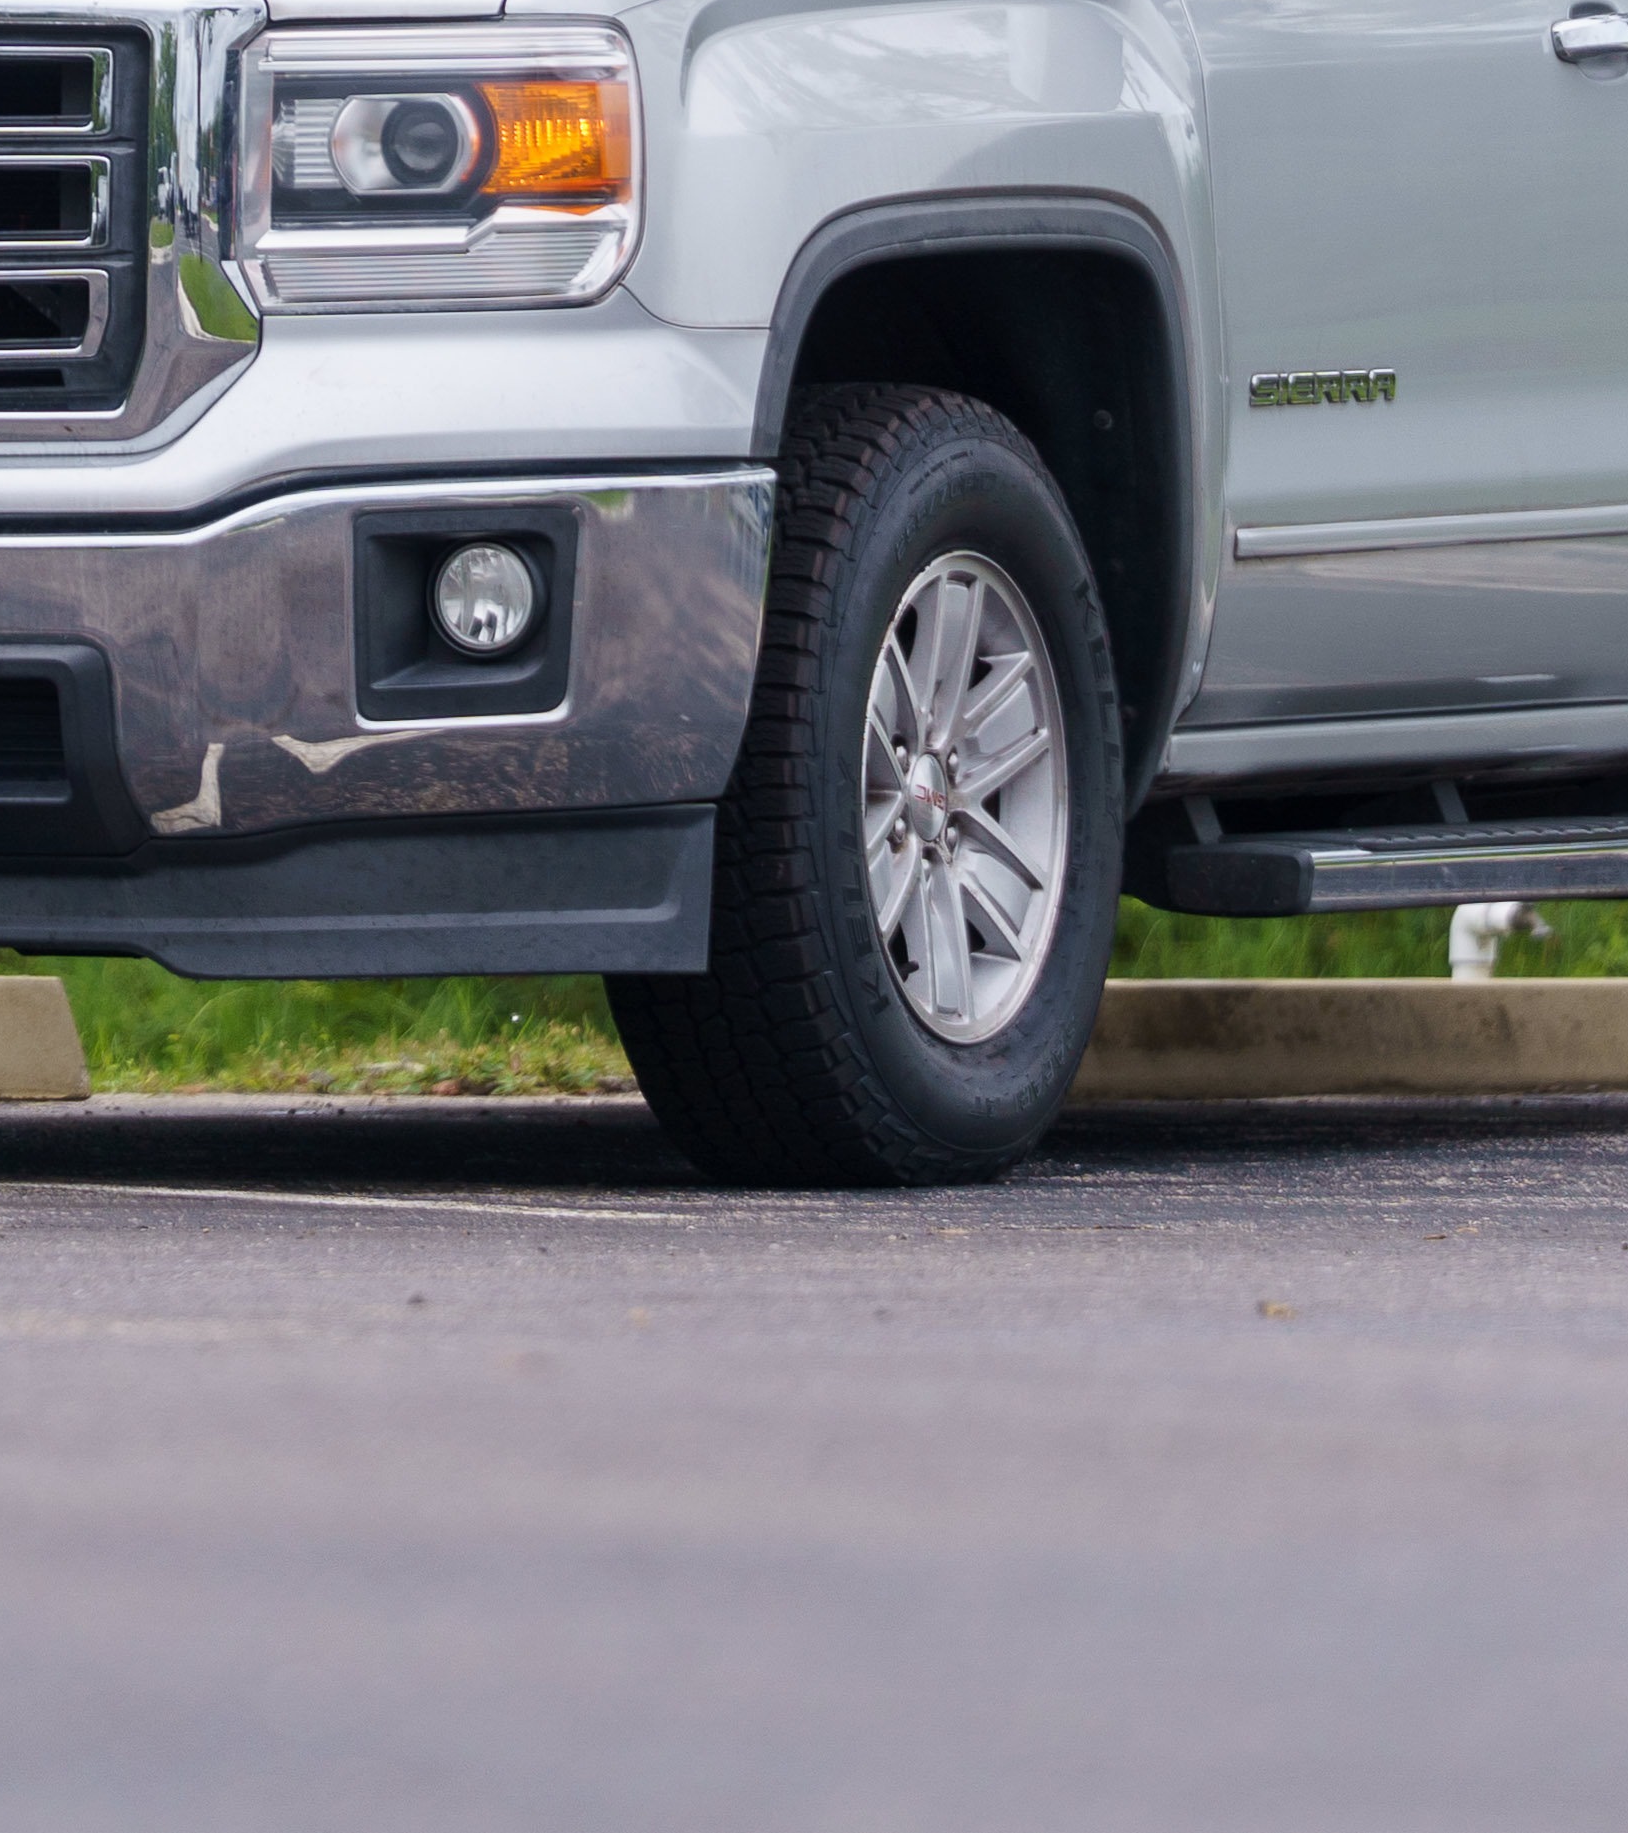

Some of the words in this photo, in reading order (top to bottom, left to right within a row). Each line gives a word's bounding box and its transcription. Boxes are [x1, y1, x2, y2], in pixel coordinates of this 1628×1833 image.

[1249, 368, 1397, 407] SIERRA
[1072, 579, 1122, 839] KELLY
[914, 784, 948, 811] GMC
[836, 756, 891, 1016] KELLY
